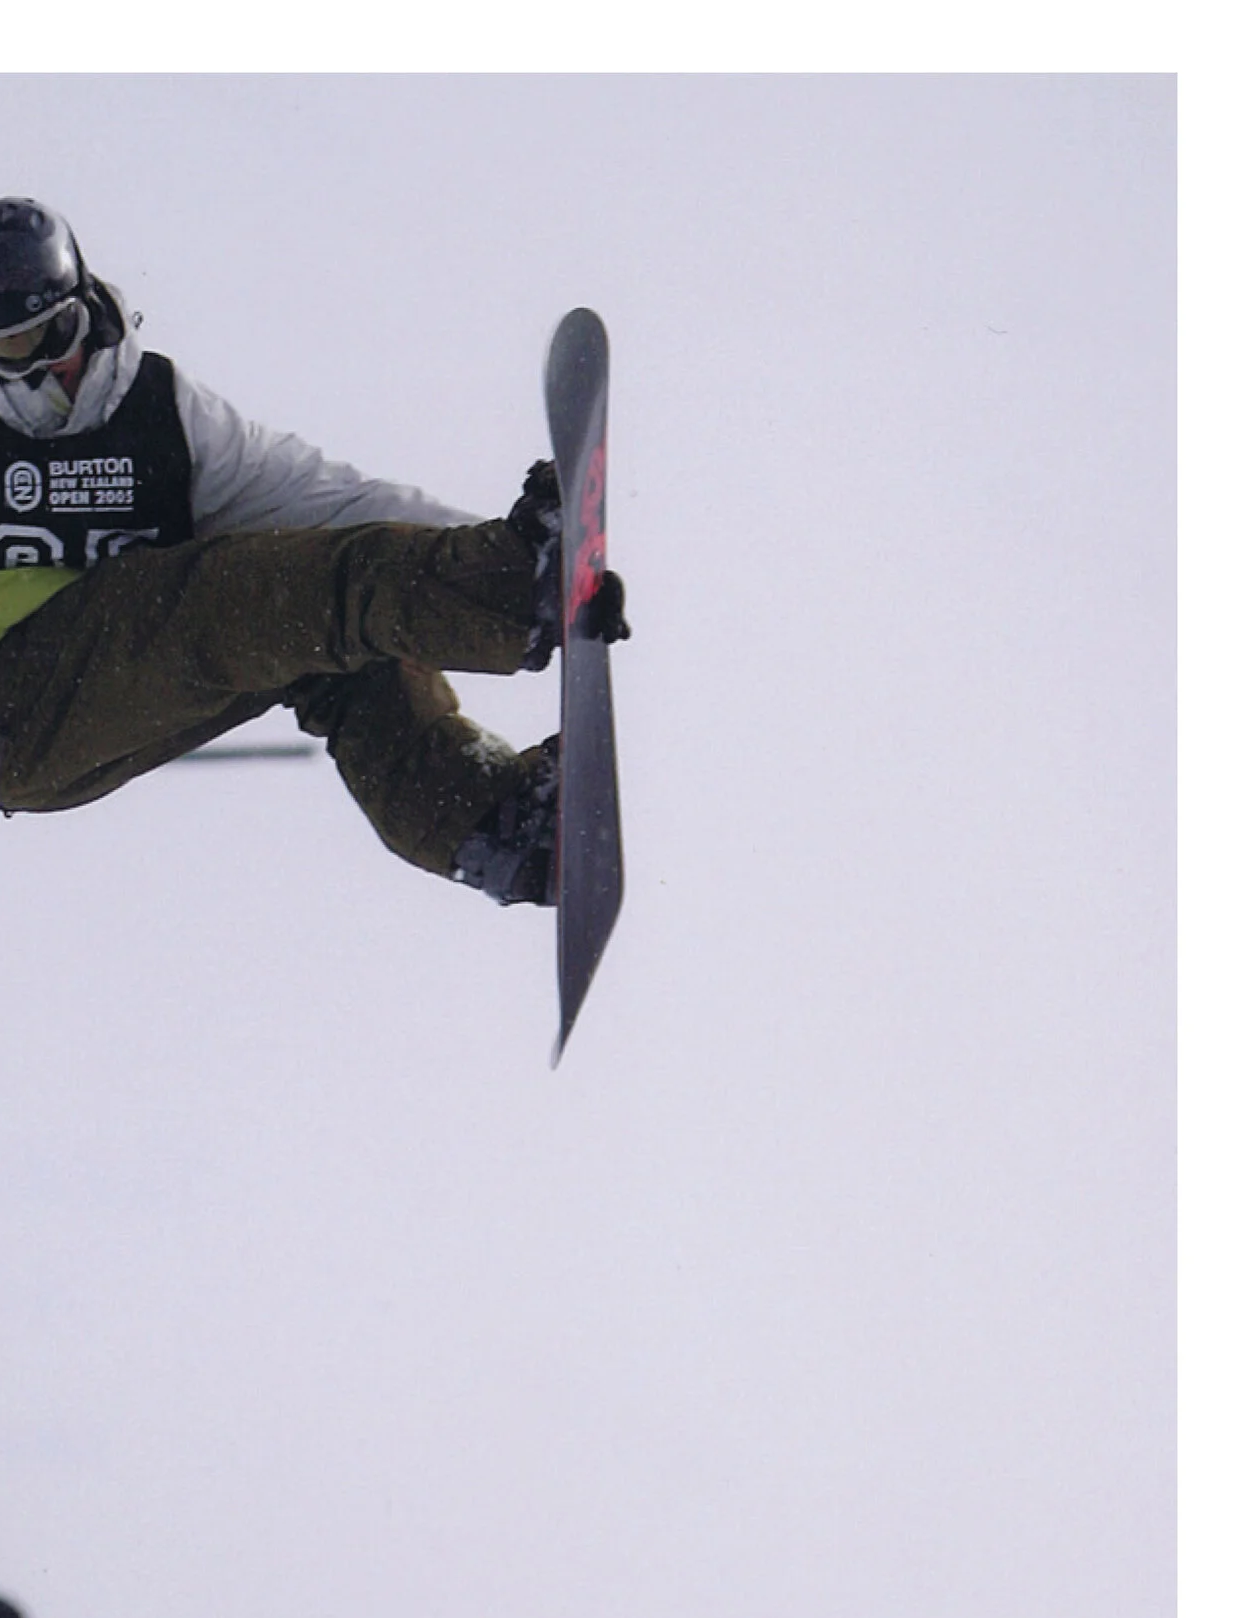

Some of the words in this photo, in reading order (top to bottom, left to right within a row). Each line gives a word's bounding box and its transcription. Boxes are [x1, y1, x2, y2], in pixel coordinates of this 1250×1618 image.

[50, 478, 78, 488] NEW
[49, 492, 90, 504] OPEN
[94, 490, 134, 504] 2005
